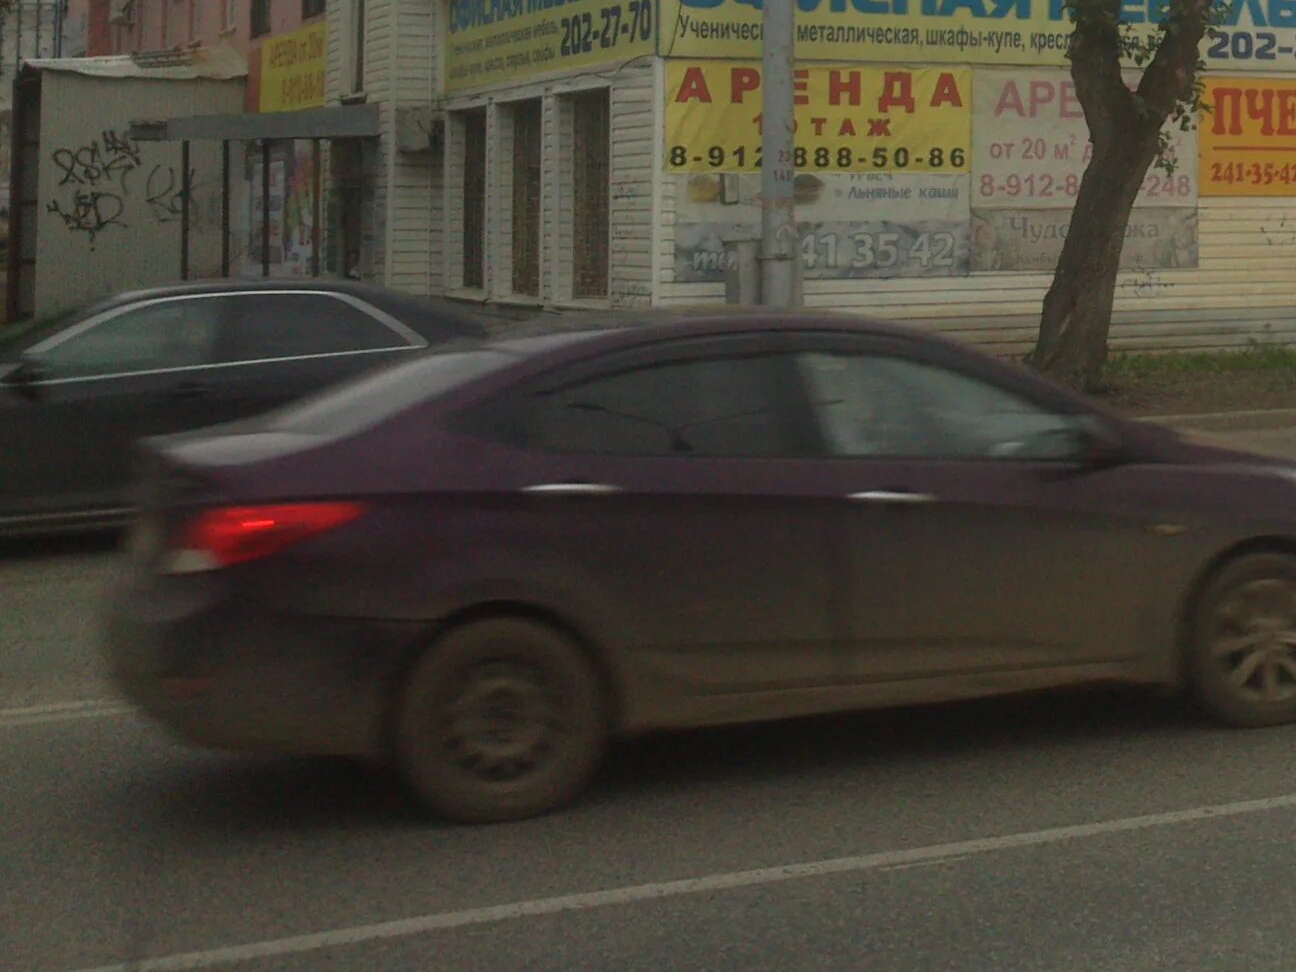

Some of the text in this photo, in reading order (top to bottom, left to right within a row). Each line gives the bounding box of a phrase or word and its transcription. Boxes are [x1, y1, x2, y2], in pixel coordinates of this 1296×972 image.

[926, 28, 1026, 54] шкафы-купе,
[674, 66, 964, 114] АРЕНДА
[791, 117, 893, 137] ТАЖ
[1021, 138, 1046, 160] 20
[852, 232, 898, 269] 35
[910, 232, 955, 268] 42
